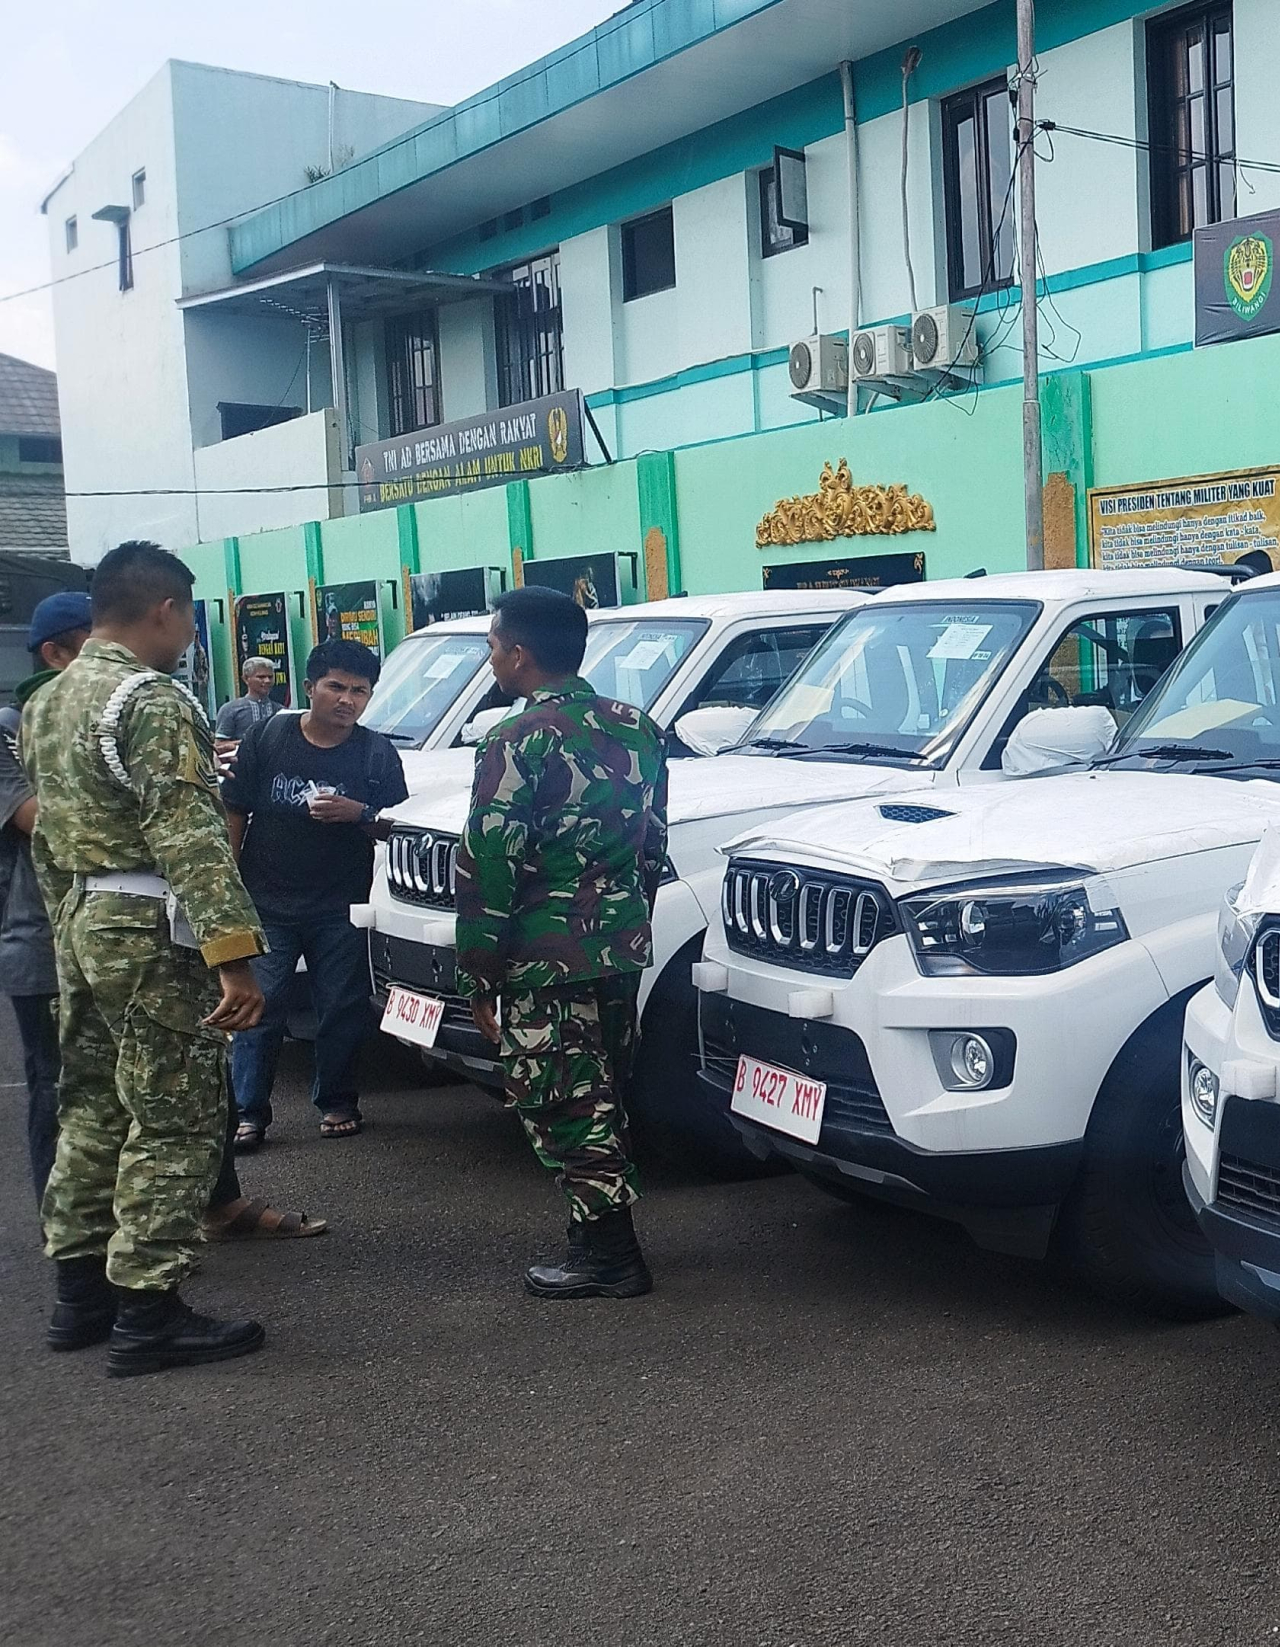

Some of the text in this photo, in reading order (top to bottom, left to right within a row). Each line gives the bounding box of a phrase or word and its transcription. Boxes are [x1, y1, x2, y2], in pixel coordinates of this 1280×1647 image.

[383, 413, 538, 473] TNI AD BERSAMA DENGAN RAKYAT
[520, 445, 543, 472] NKRI
[1100, 479, 1275, 515] VISI PRESIDEN TENTANG MILITER YANG KUAT
[1144, 532, 1179, 544] melindungi
[1200, 529, 1224, 541] dengan
[1146, 519, 1181, 531] melindungi
[1203, 516, 1227, 527] dengan
[1144, 545, 1180, 557] melindungi
[1200, 541, 1225, 553] dengan
[386, 990, 442, 1031] B 9430 XMY
[737, 1058, 822, 1121] B 9427 XMY
